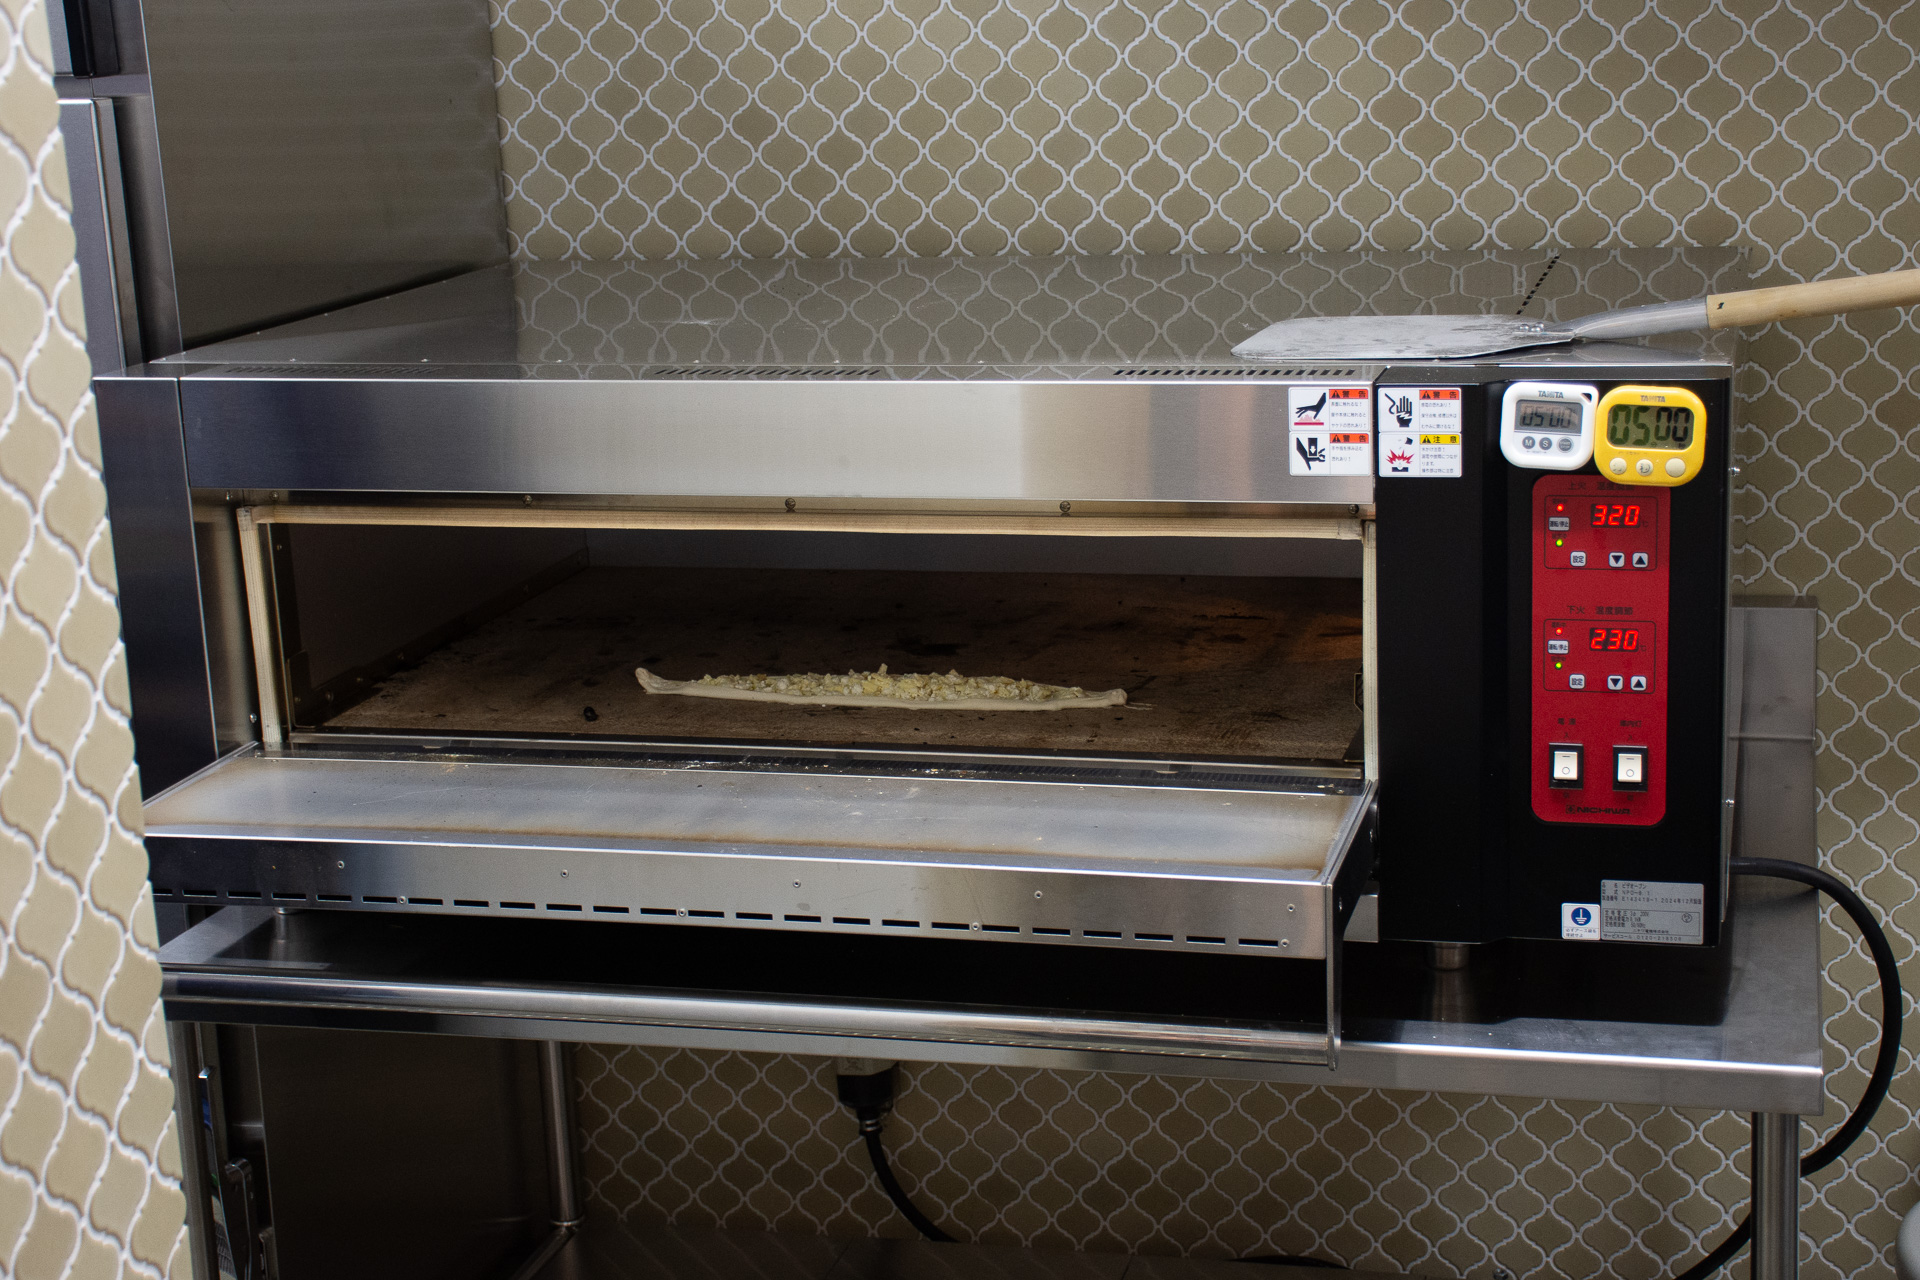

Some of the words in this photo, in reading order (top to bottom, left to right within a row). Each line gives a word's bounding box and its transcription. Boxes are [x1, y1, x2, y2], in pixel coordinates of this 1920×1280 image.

[1342, 390, 1367, 398] 警告
[1432, 391, 1457, 399] 警告
[1538, 390, 1564, 398] TANITA
[1640, 394, 1666, 403] TANITA
[1343, 434, 1367, 443] 警告
[1433, 435, 1457, 443] 注意
[1592, 505, 1641, 526] 320
[1567, 605, 1585, 614] 下火
[1590, 629, 1639, 650] 230
[1577, 806, 1631, 815] NICHIWA
